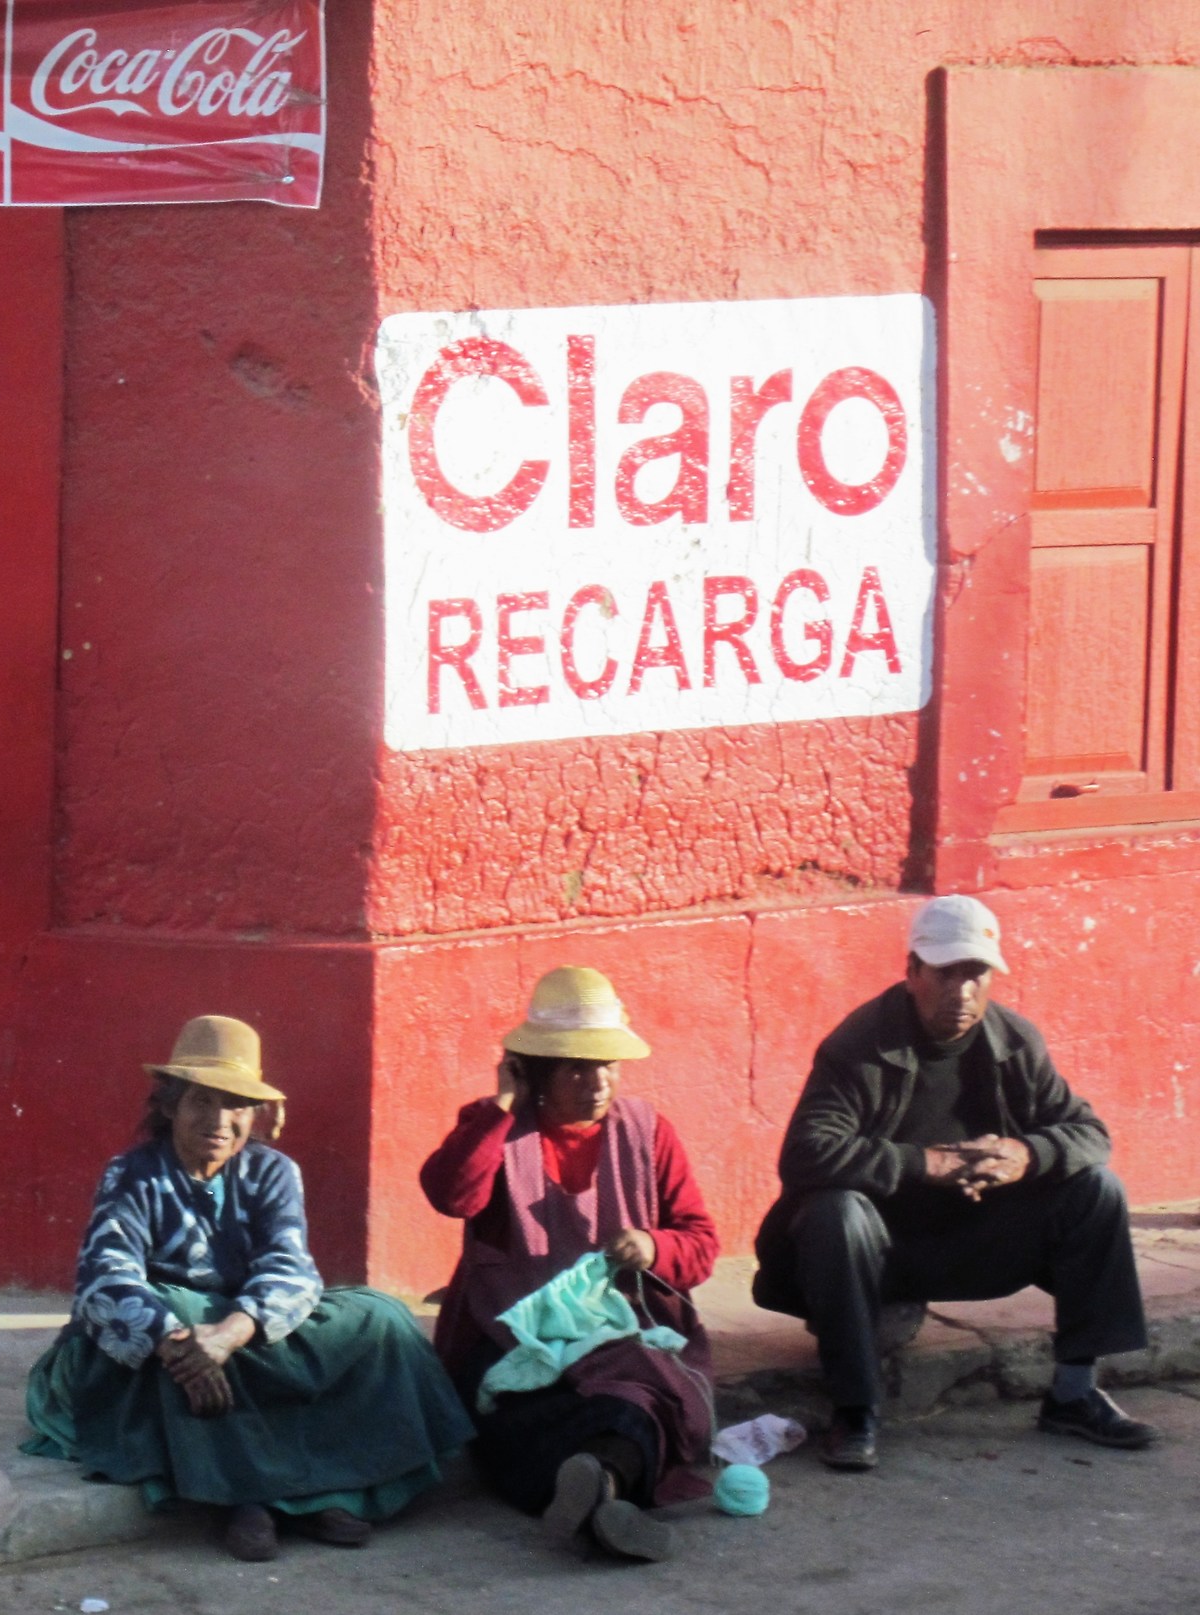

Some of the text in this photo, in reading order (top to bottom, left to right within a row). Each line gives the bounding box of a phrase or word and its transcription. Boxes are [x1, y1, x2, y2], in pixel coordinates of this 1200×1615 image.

[30, 28, 308, 118] Coca-Cola
[408, 334, 909, 534] Claro
[426, 566, 902, 715] RECARGA
